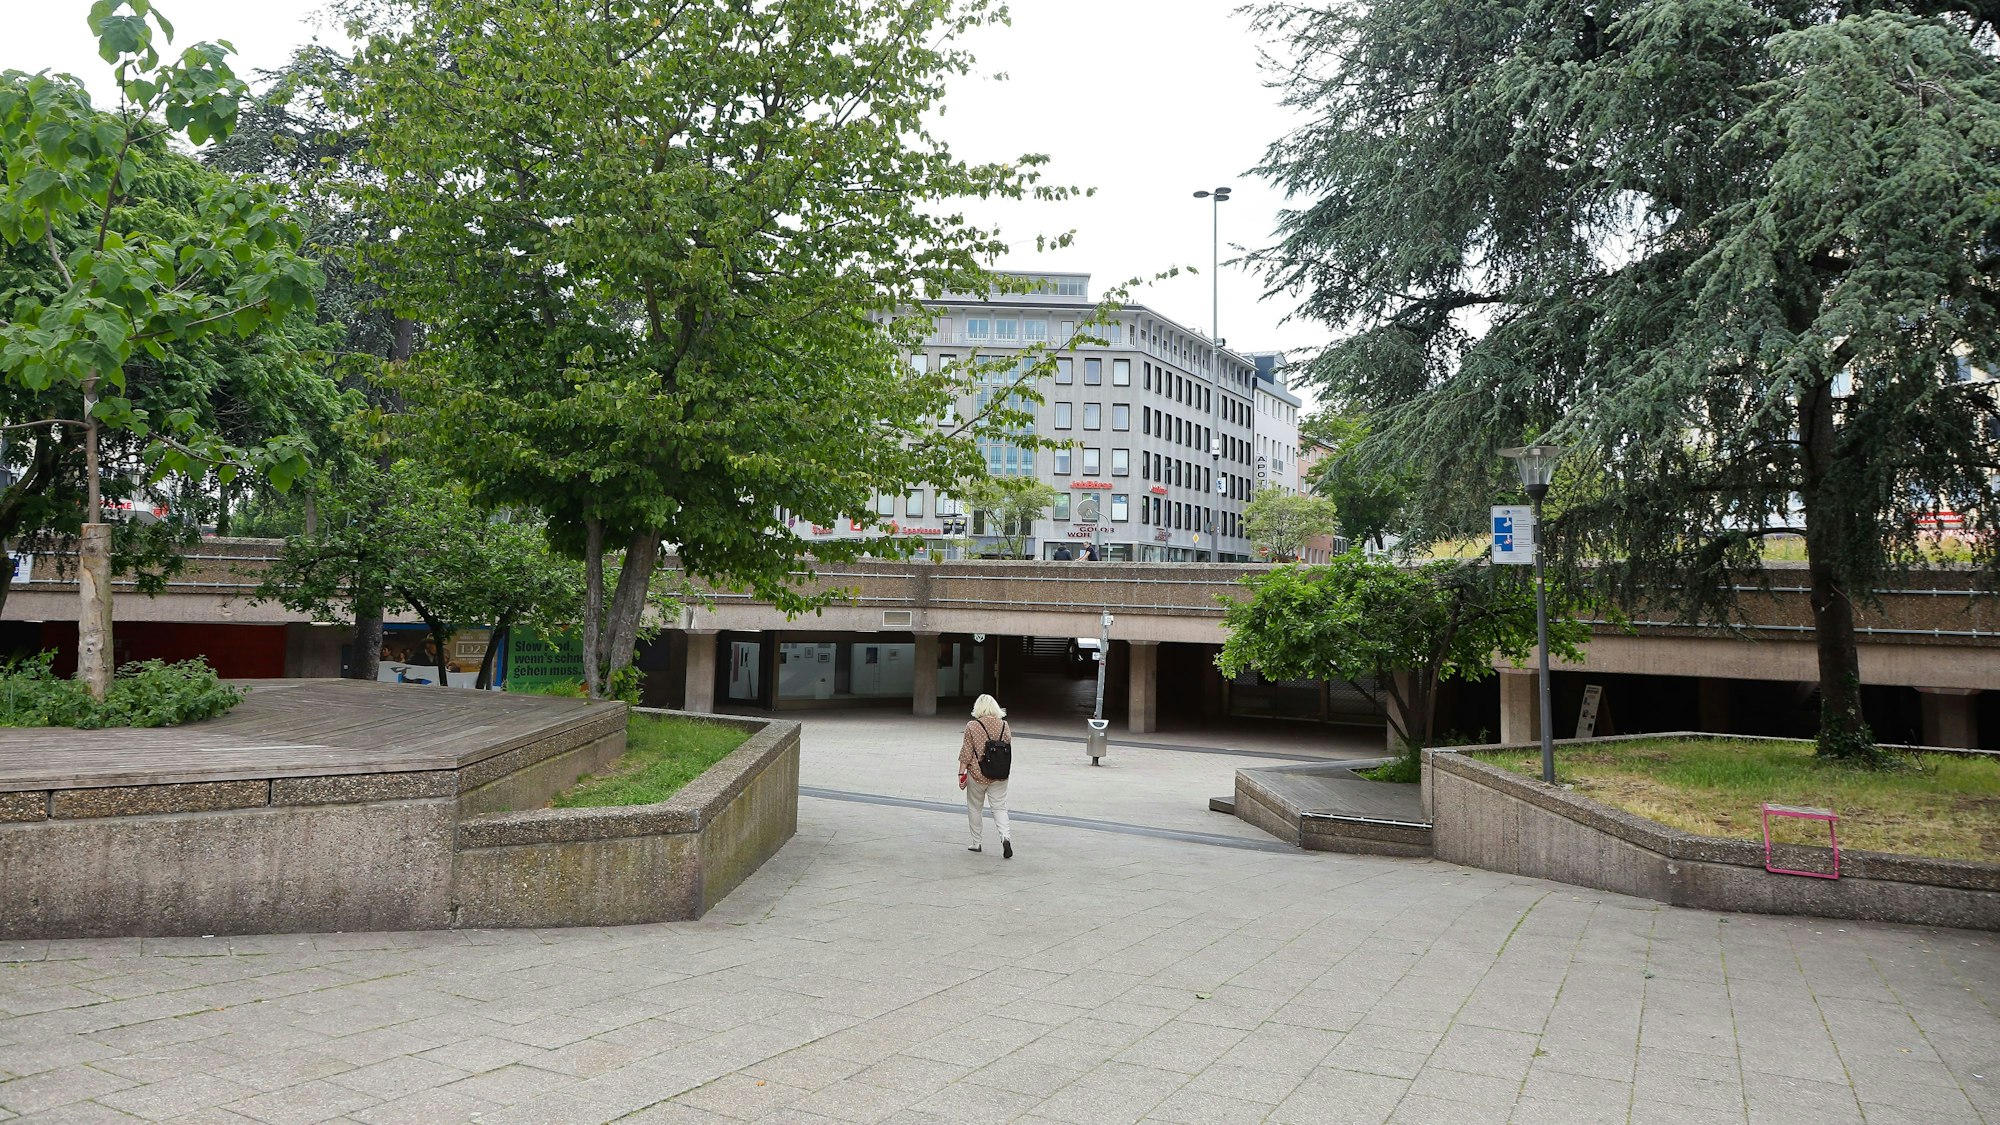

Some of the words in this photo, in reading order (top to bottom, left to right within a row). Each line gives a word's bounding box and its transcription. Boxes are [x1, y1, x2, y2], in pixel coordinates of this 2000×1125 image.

[902, 526, 942, 535] Sparkasse
[460, 644, 488, 654] 1923
[515, 640, 542, 652] Slow
[514, 652, 553, 664] wenn's
[513, 665, 547, 679] gehen
[550, 666, 582, 676] muss.
